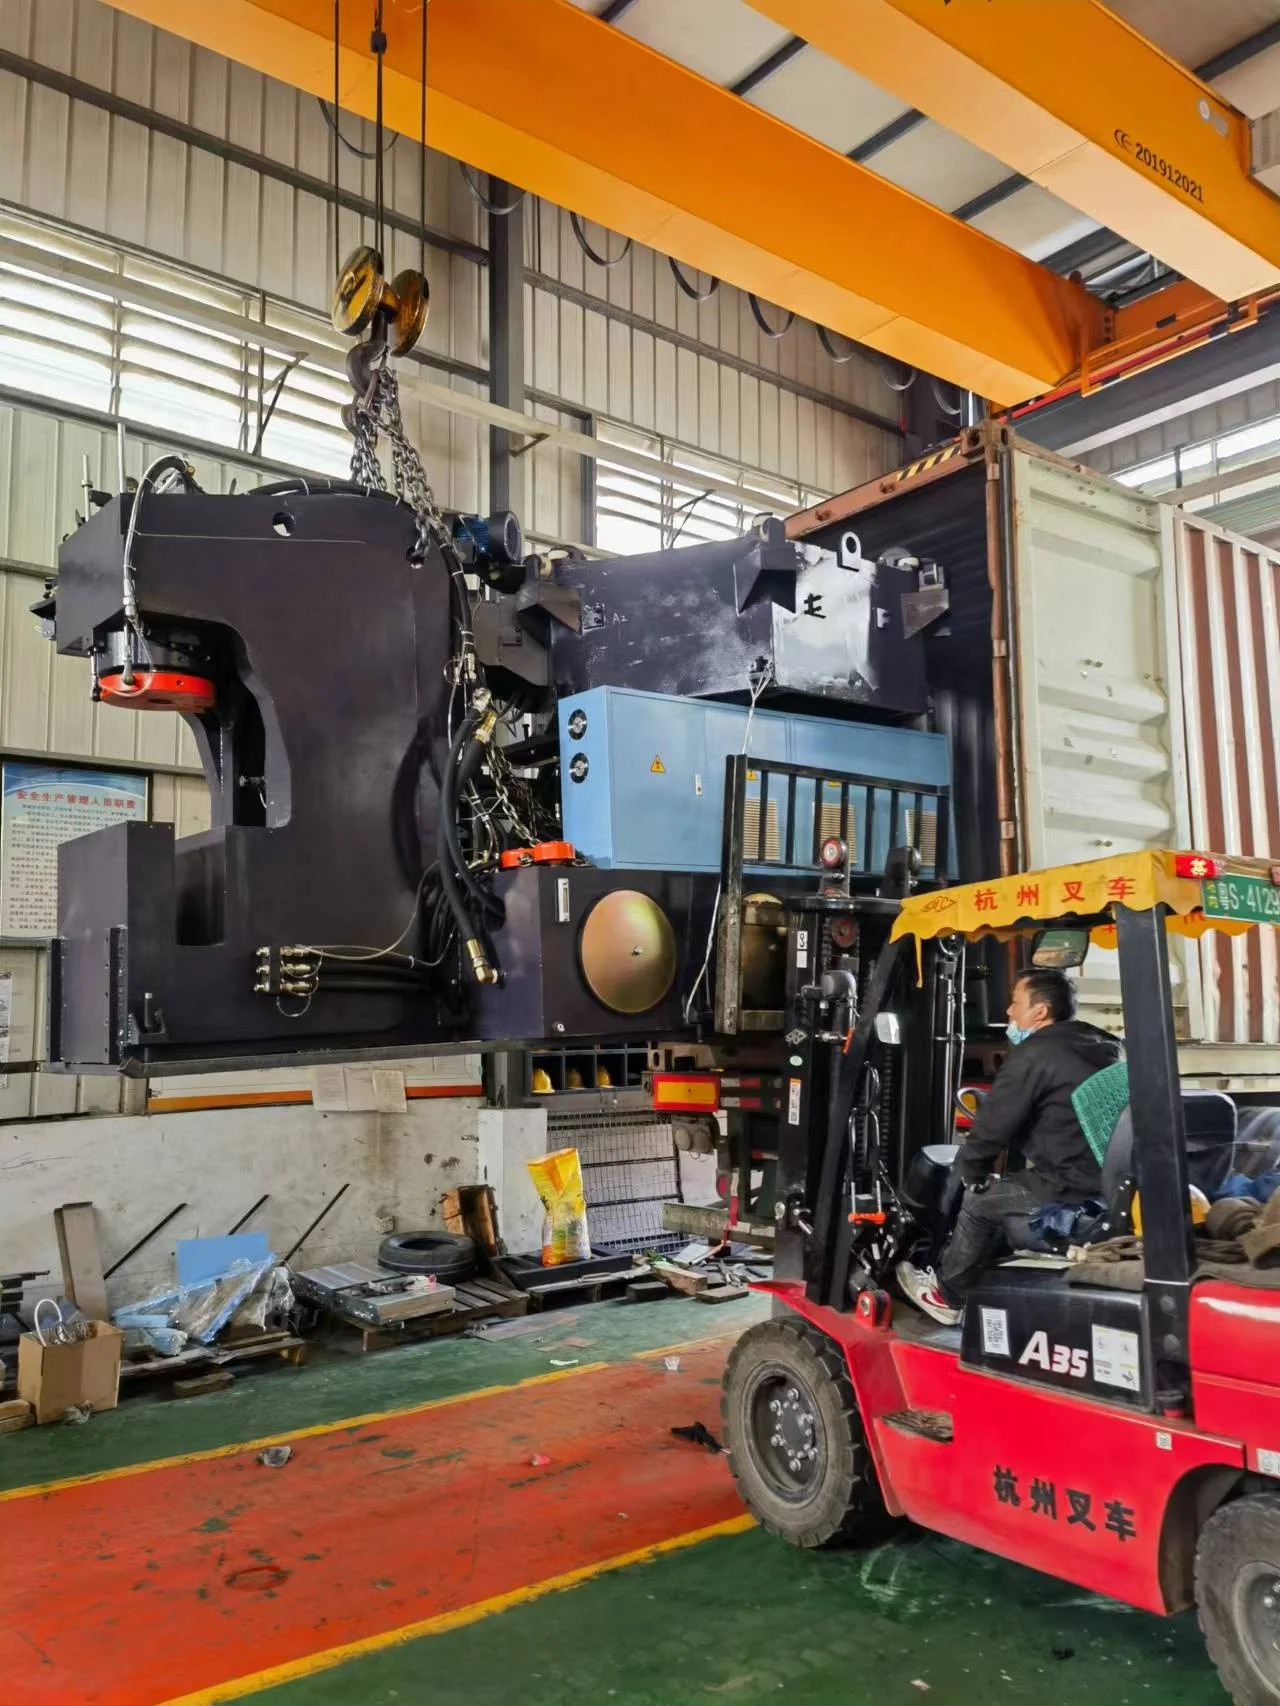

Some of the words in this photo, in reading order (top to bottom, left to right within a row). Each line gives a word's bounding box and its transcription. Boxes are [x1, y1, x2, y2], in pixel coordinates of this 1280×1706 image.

[1135, 142, 1204, 203] 201912021
[16, 790, 137, 809] 安全生产管理人员职责
[974, 876, 1137, 912] 杭州叉车
[1018, 1330, 1089, 1378] A35
[993, 1465, 1137, 1541] 杭州叉车
